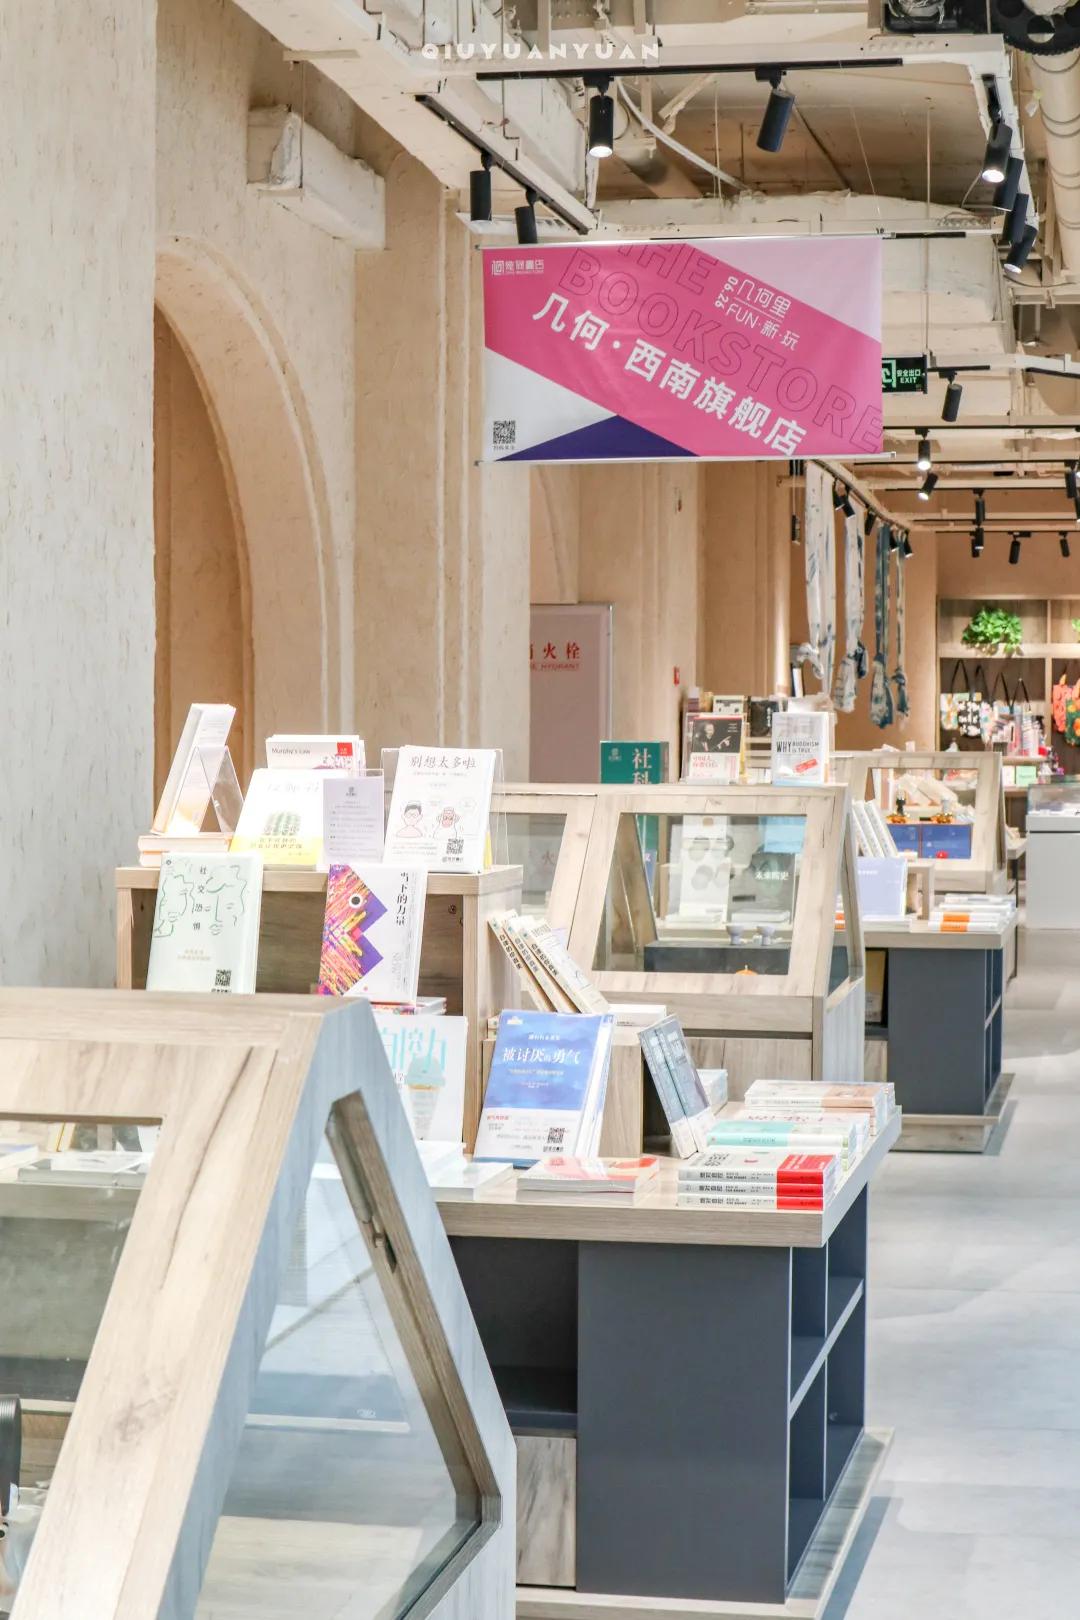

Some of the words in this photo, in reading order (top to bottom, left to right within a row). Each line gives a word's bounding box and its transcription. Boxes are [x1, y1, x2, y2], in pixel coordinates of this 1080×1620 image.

[558, 246, 884, 454] BOOKSTORE
[896, 369, 921, 378] 安全出口
[900, 376, 917, 384] EXIT
[530, 641, 580, 661] 火栓
[776, 741, 791, 753] WHY
[409, 755, 477, 769] 别想太多啦
[503, 1047, 582, 1064] 被讨厌的勇气
